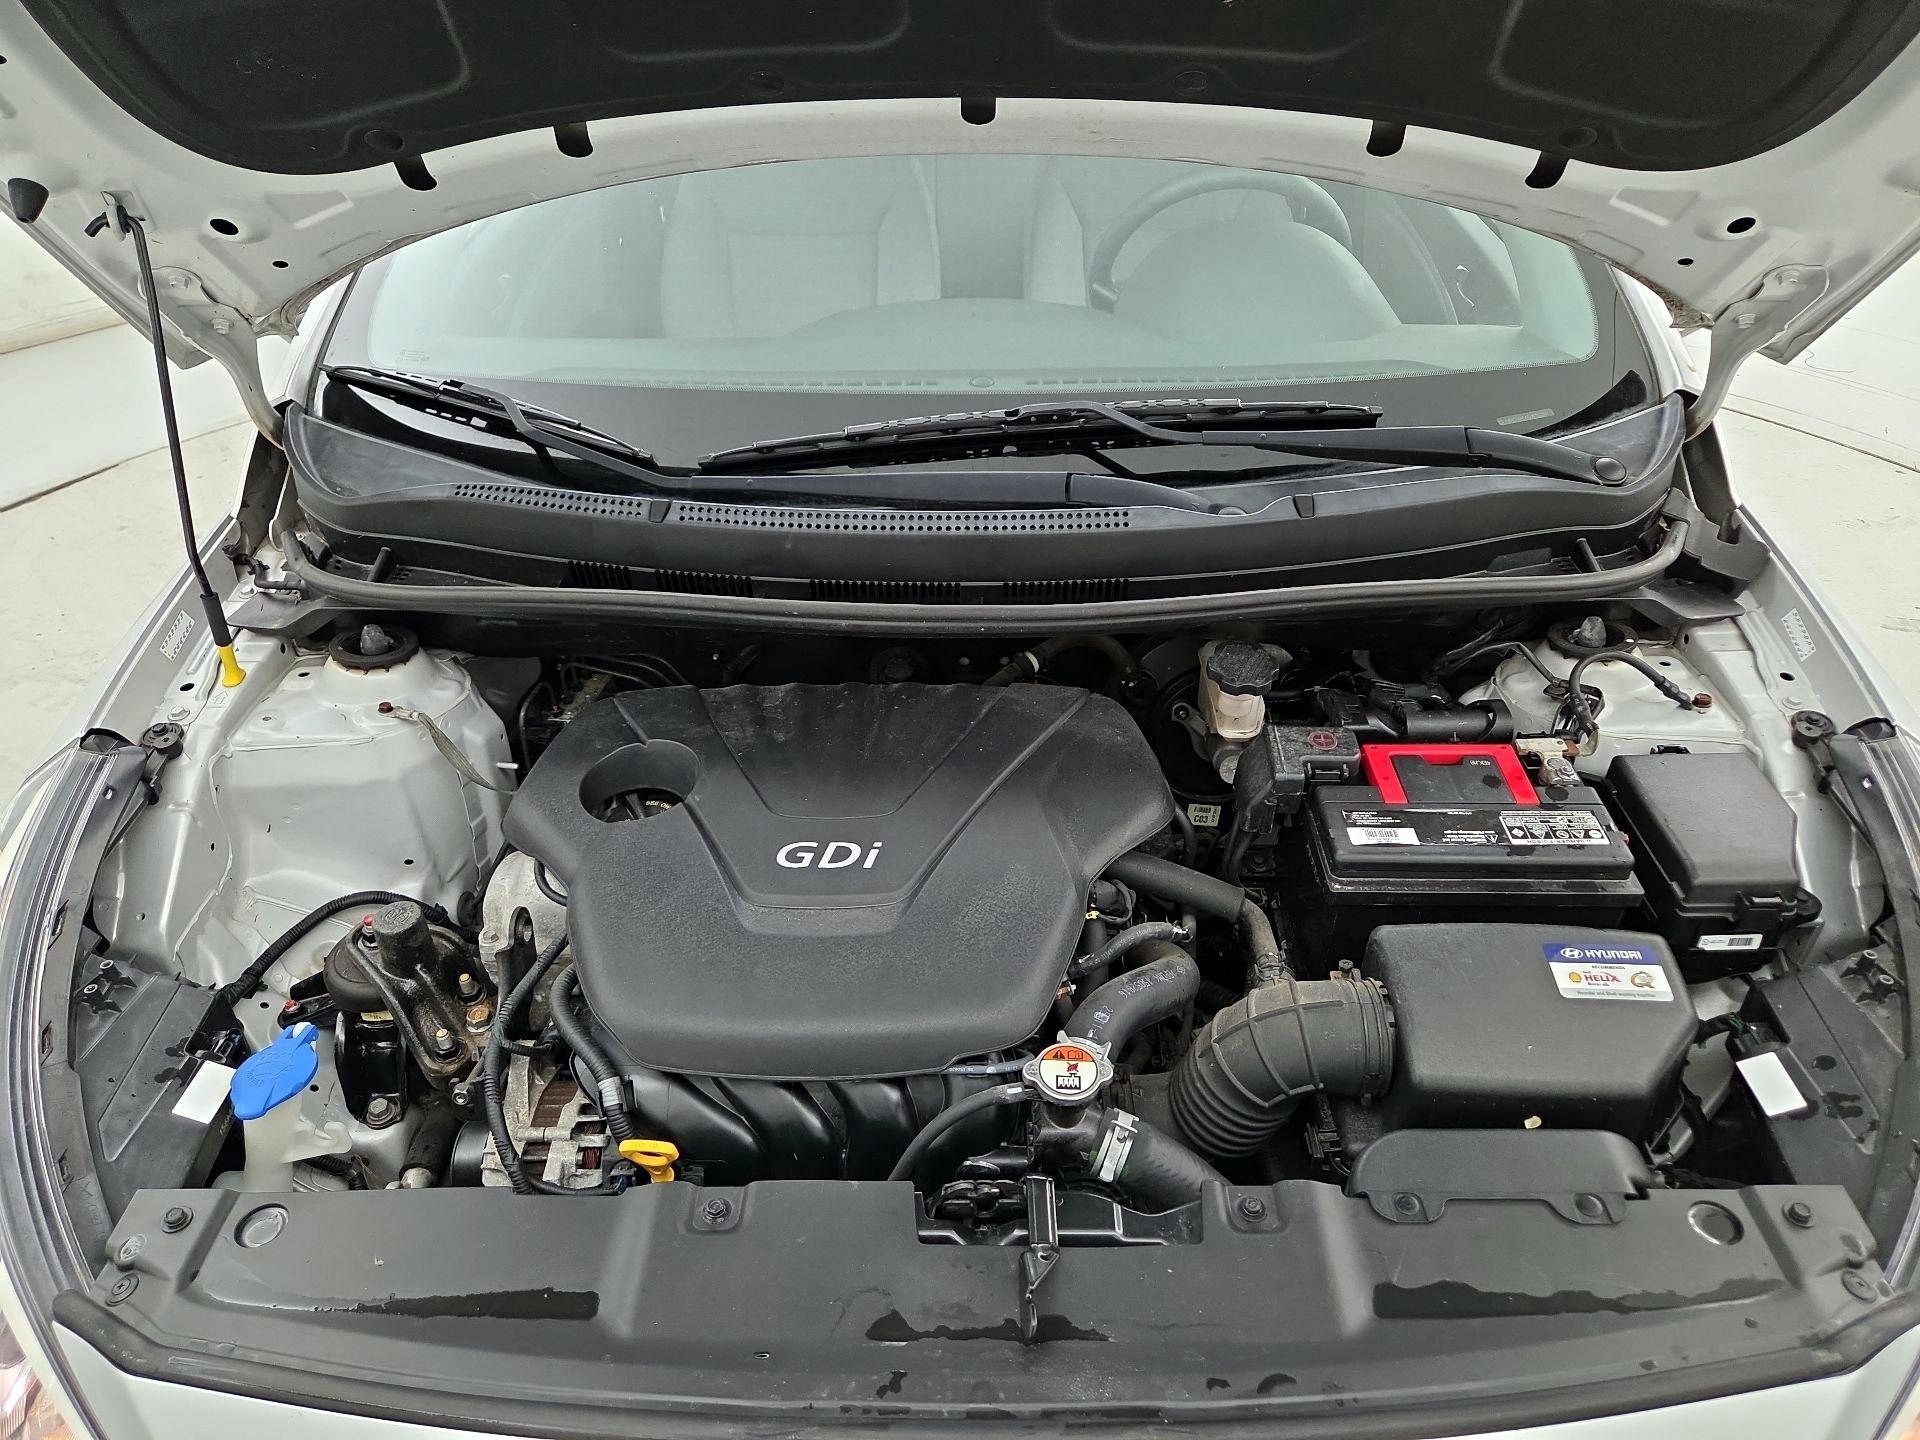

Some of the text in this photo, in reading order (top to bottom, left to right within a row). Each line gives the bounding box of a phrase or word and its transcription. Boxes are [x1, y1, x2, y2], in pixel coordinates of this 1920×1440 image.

[776, 841, 883, 869] GDi
[1585, 949, 1643, 960] HYUNDAI
[1584, 973, 1622, 983] HELIX
